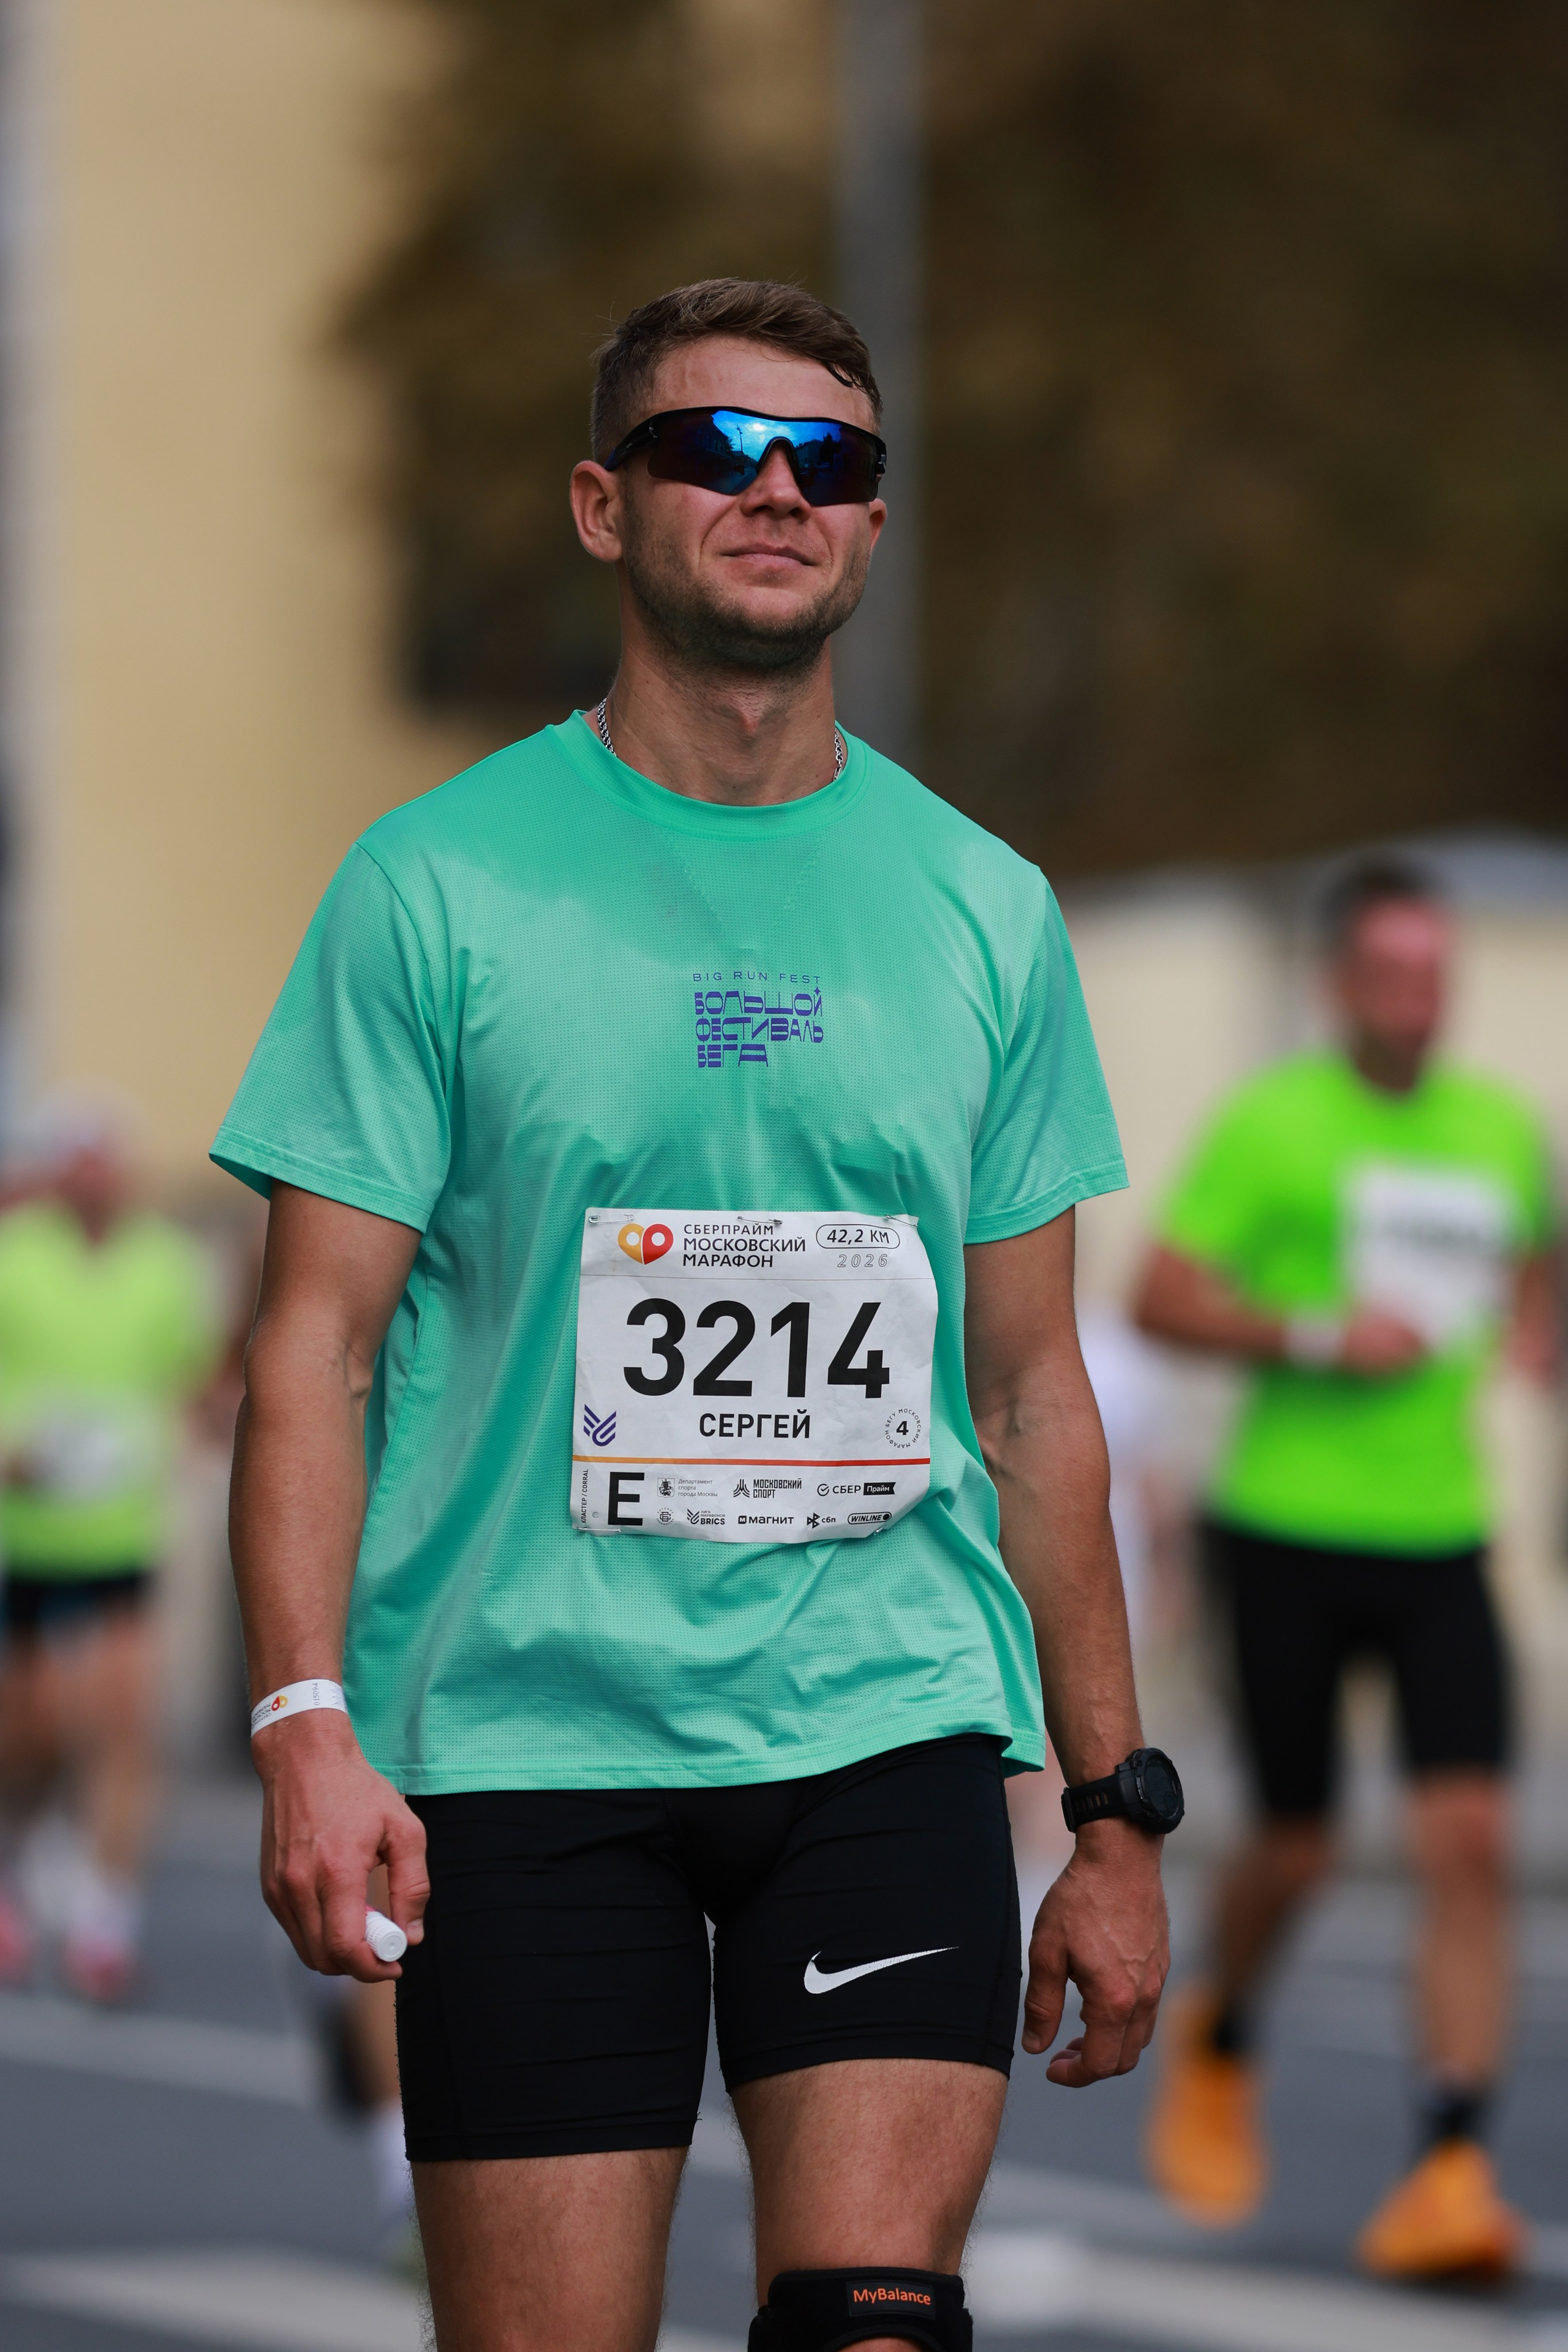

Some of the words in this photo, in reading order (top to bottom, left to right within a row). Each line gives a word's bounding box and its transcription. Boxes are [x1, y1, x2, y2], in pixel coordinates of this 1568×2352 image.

[693, 973, 722, 982] BIG
[734, 970, 767, 981] RUN
[780, 972, 820, 984] FEST
[695, 986, 823, 1017] БОЛЬШОЙ
[696, 1016, 823, 1043] ФЕСТИВАЛЬ
[697, 1044, 768, 1068] БЕГА
[684, 1223, 773, 1235] СБЕРПРАЙМ
[827, 1229, 863, 1245] 42,2
[870, 1229, 890, 1243] КМ
[684, 1237, 805, 1251] МОСКОВСКИЙ
[684, 1254, 772, 1267] МАРАФОН
[837, 1254, 887, 1267] 2026
[624, 1298, 889, 1398] 3214
[700, 1409, 810, 1438] СЕРГЕЙ
[897, 1421, 908, 1435] 4
[899, 1408, 921, 1443] МОСКОВСКИЙ
[884, 1430, 911, 1449] МАРАФОН
[753, 1478, 802, 1489] МОСКОВСКИЙ
[608, 1472, 644, 1526] E
[753, 1489, 776, 1498] СПОРТ
[854, 2288, 930, 2305] MyBalance
